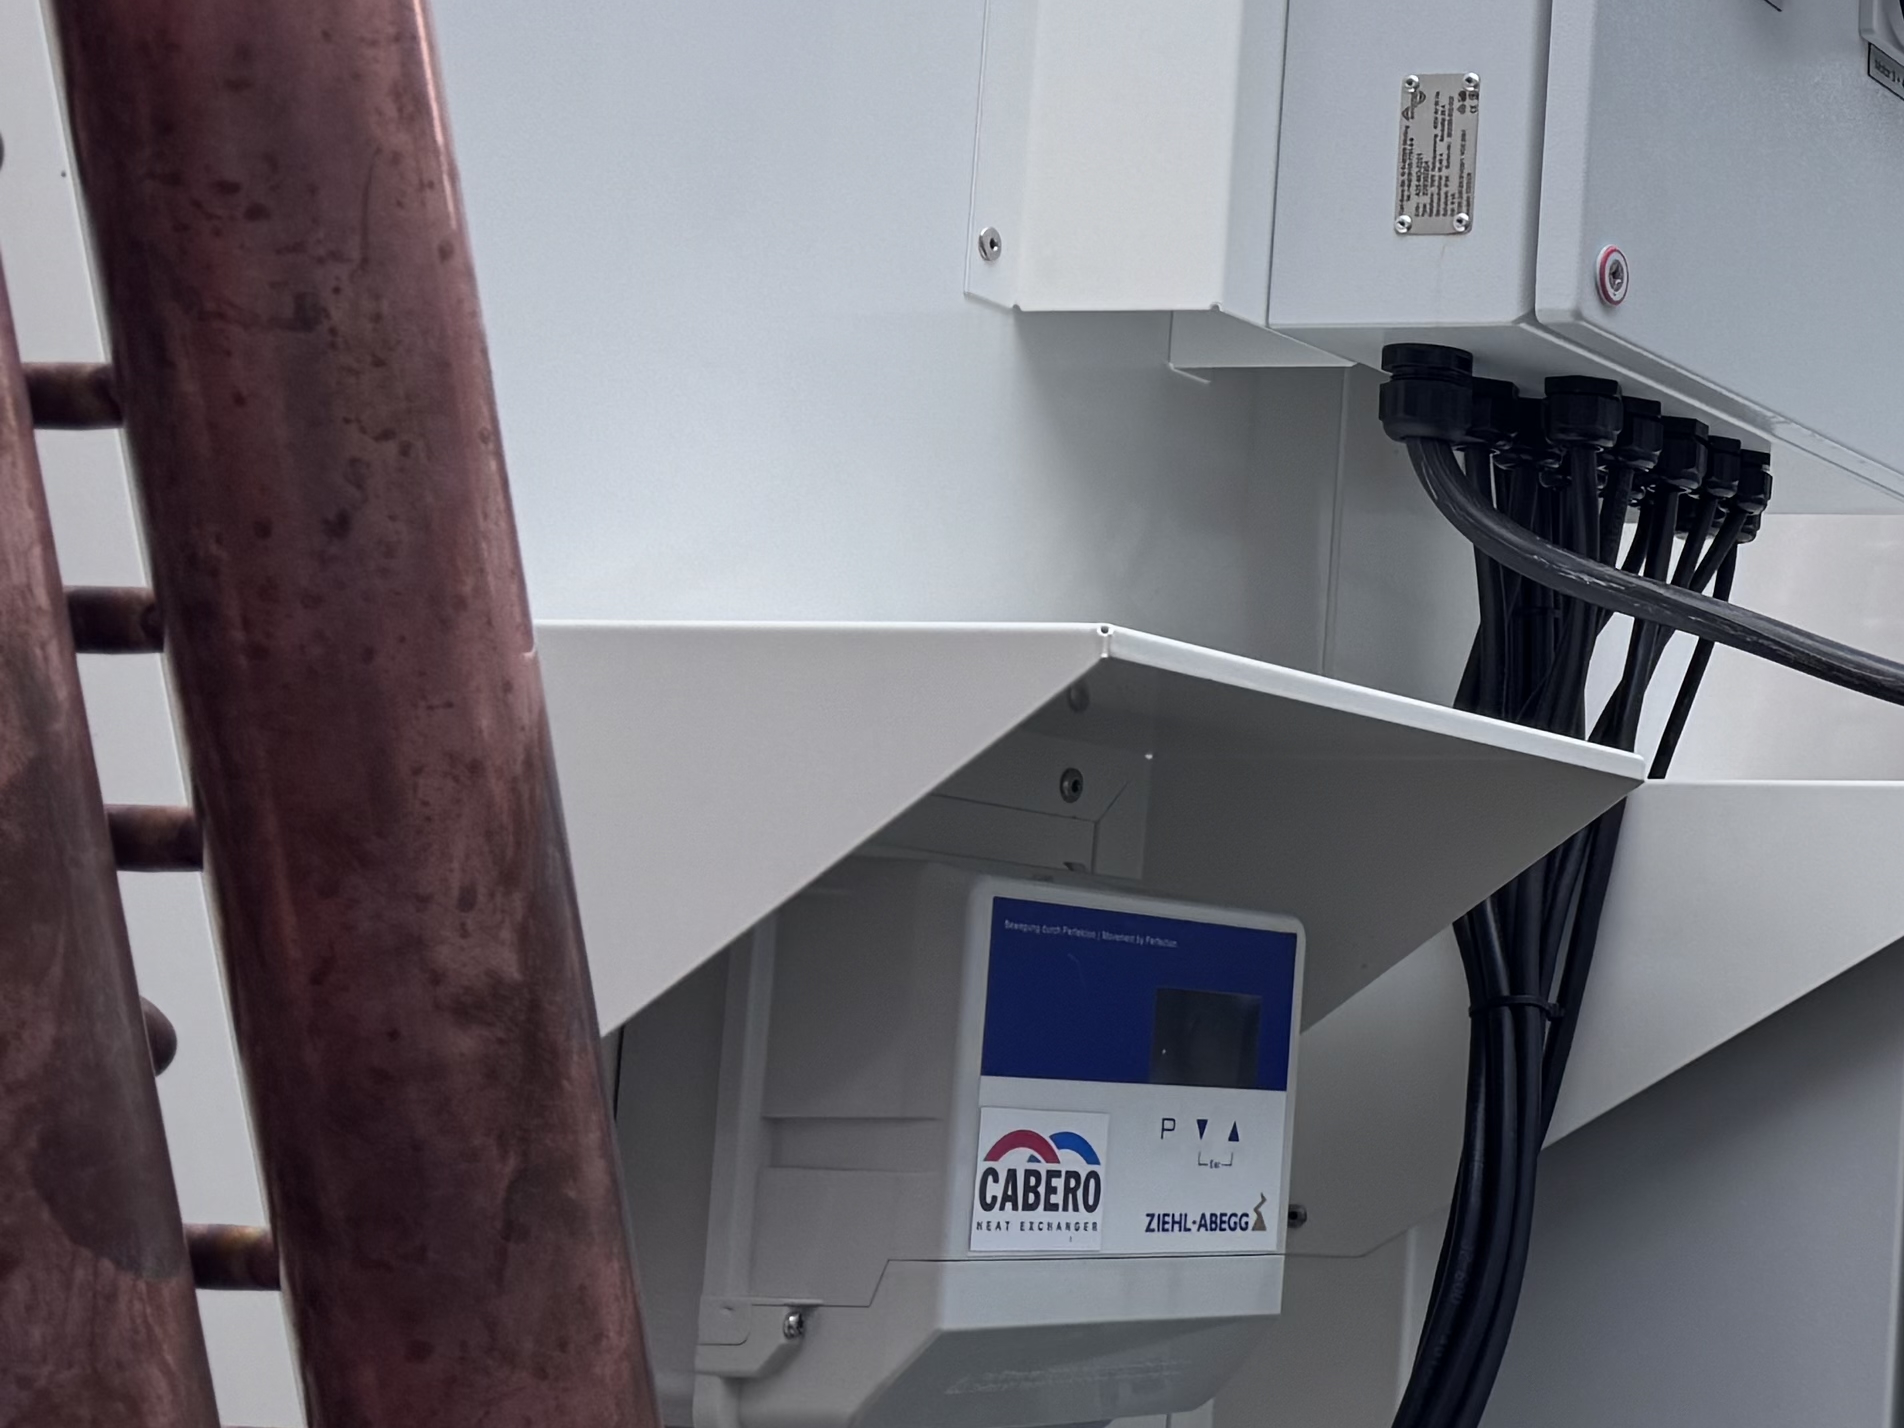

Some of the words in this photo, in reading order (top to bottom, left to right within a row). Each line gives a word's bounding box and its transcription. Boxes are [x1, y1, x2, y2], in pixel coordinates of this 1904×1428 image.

[1160, 1118, 1176, 1140] P
[978, 1167, 1101, 1213] CABERO
[976, 1221, 1010, 1232] HEAT
[1020, 1221, 1098, 1232] EXCHANGER
